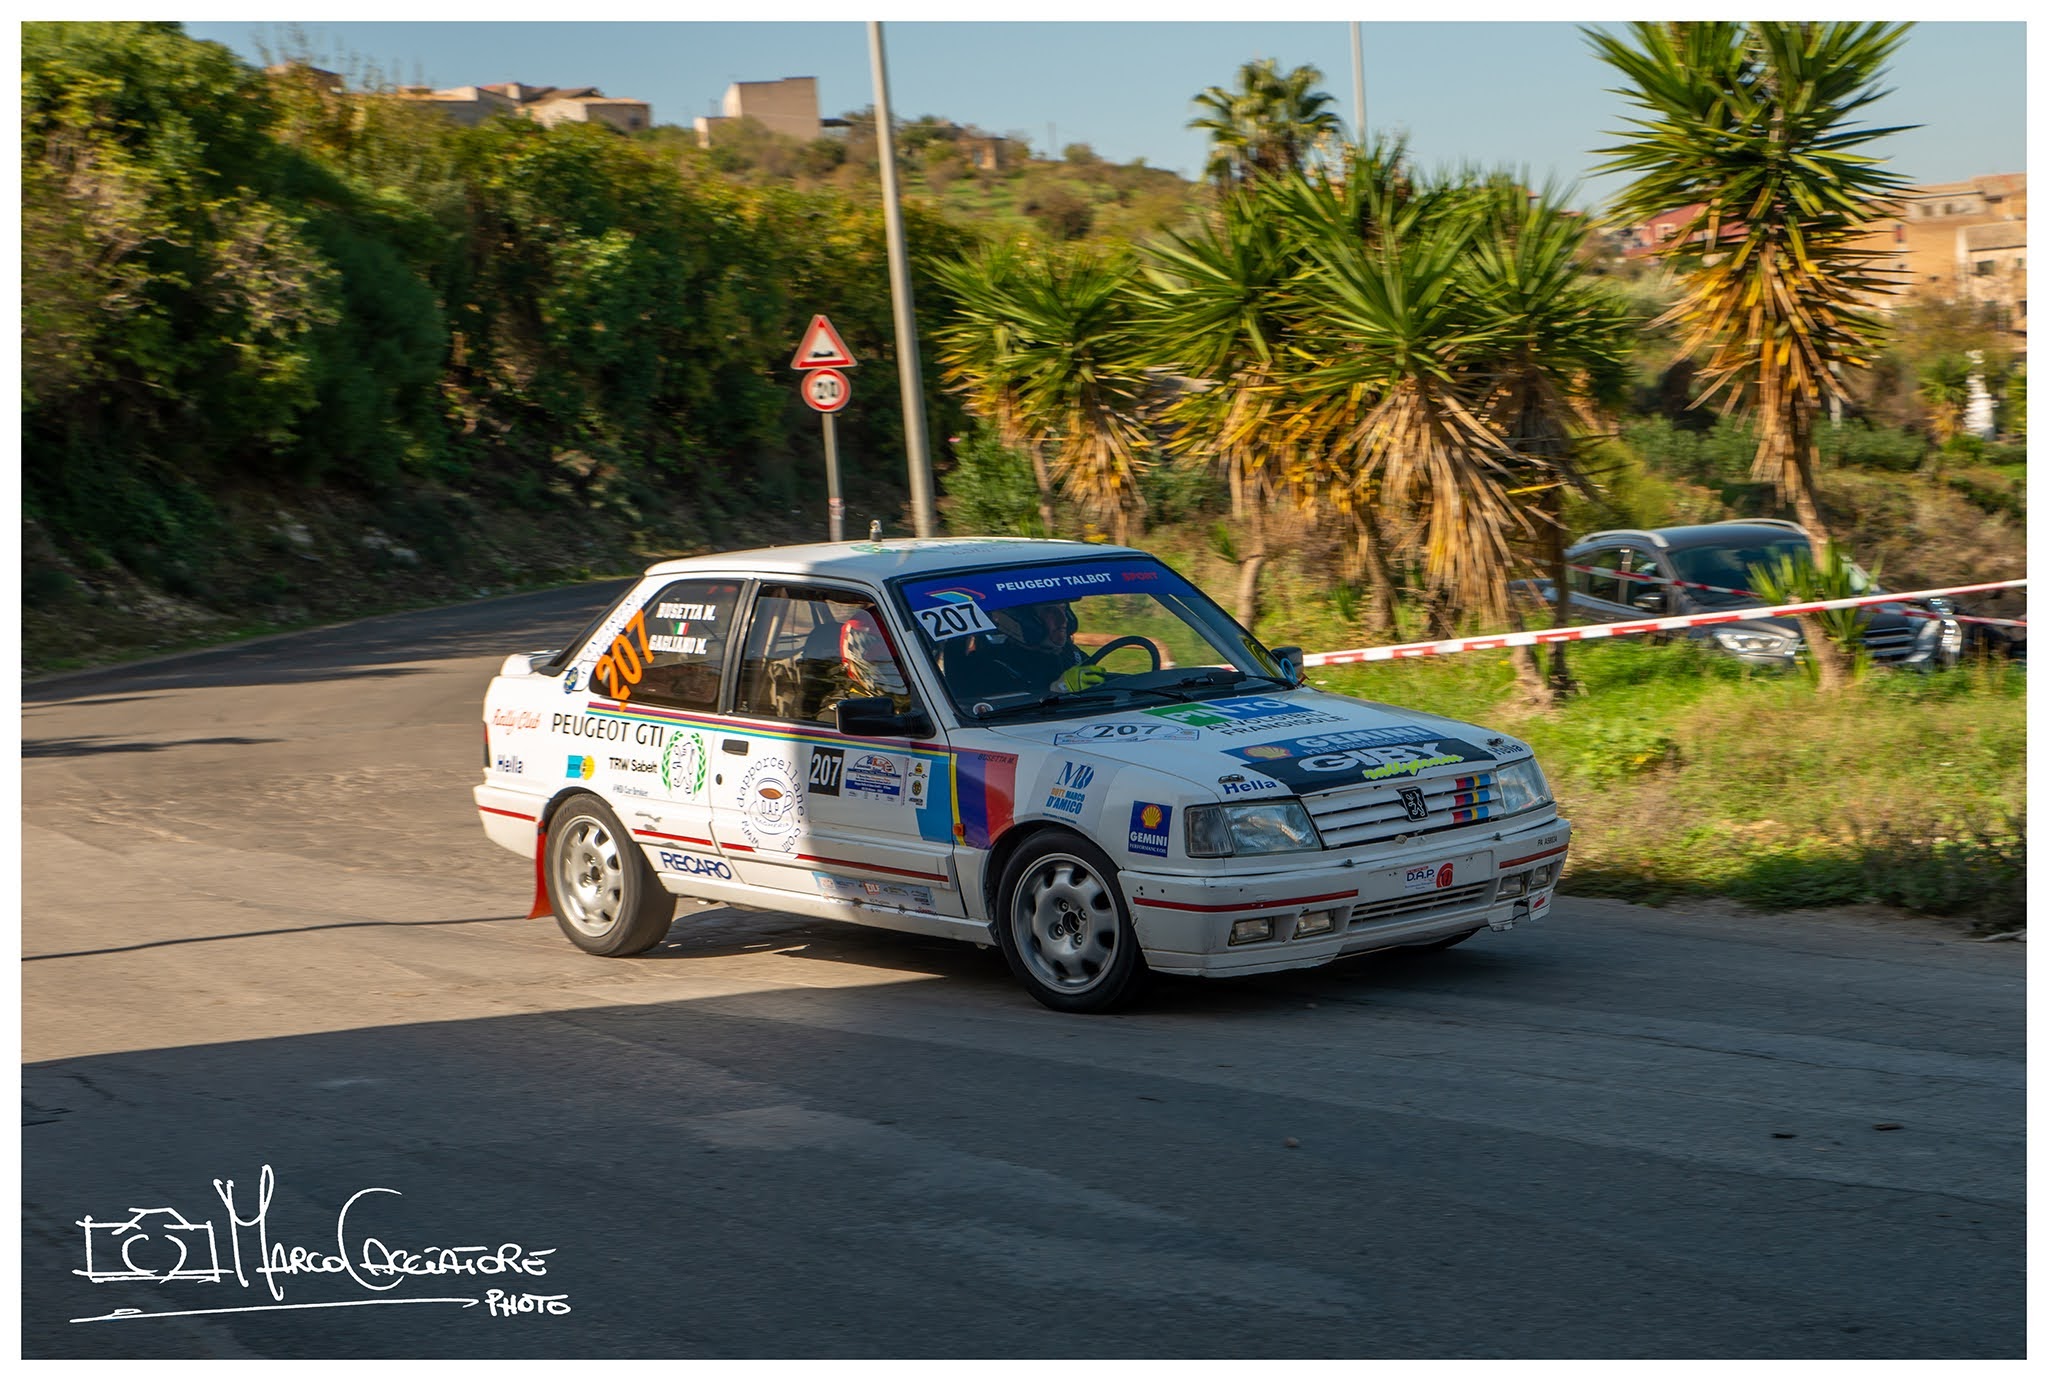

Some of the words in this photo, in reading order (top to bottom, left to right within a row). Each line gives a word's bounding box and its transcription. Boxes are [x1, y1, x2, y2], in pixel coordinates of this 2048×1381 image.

[815, 380, 839, 400] 20
[996, 577, 1061, 592] PEUGEOT
[1063, 573, 1112, 586] TALBOT
[1123, 571, 1158, 581] SPORT
[656, 602, 704, 620] BUSETTA
[921, 603, 982, 638] 207
[595, 608, 655, 712] 207
[1162, 700, 1289, 722] PINTO
[552, 713, 631, 742] PEUGEOT
[635, 723, 664, 748] GTI
[1092, 725, 1162, 738] 207
[1295, 726, 1431, 748] GEMINI
[496, 754, 524, 774] Hella
[609, 757, 630, 771] TRW
[631, 759, 658, 774] Sabelt
[978, 753, 1006, 764] BUSETTA
[1298, 742, 1446, 772] GIBY
[809, 752, 842, 787] 207
[1065, 790, 1086, 803] MARCO
[1222, 780, 1277, 794] Hella
[1045, 795, 1083, 815] D'AMICO
[1129, 831, 1167, 847] GEMINI
[660, 851, 731, 880] RECARO
[1406, 868, 1435, 882] D.A.P.
